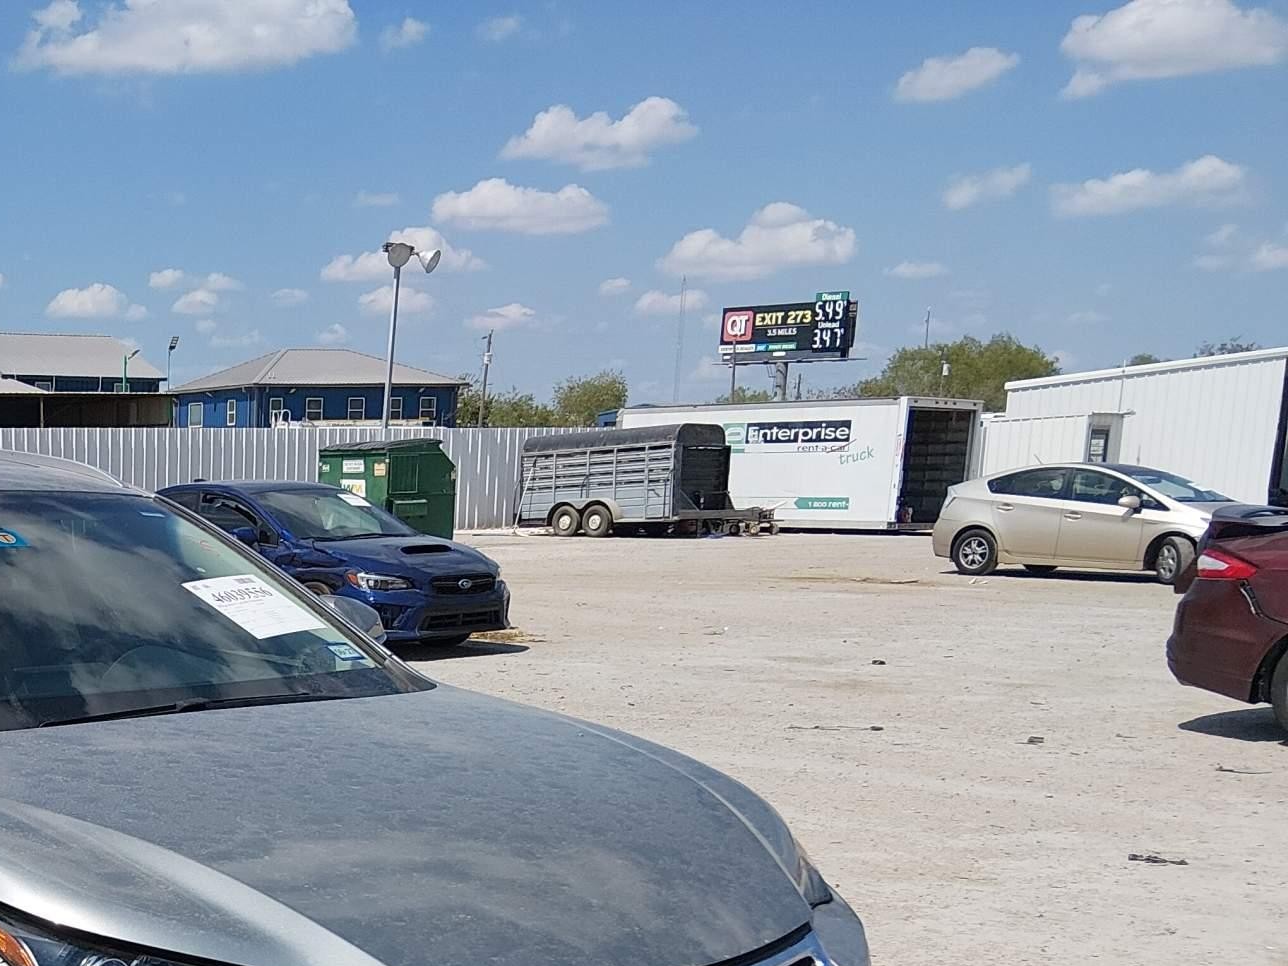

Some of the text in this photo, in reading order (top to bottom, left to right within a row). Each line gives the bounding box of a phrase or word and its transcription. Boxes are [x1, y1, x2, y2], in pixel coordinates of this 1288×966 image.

[726, 315, 749, 337] QT
[755, 310, 812, 326] EXIT 273
[777, 327, 797, 336] MILES
[747, 423, 850, 444] Enterprise
[839, 446, 875, 464] truck
[212, 586, 273, 604] 46039556
